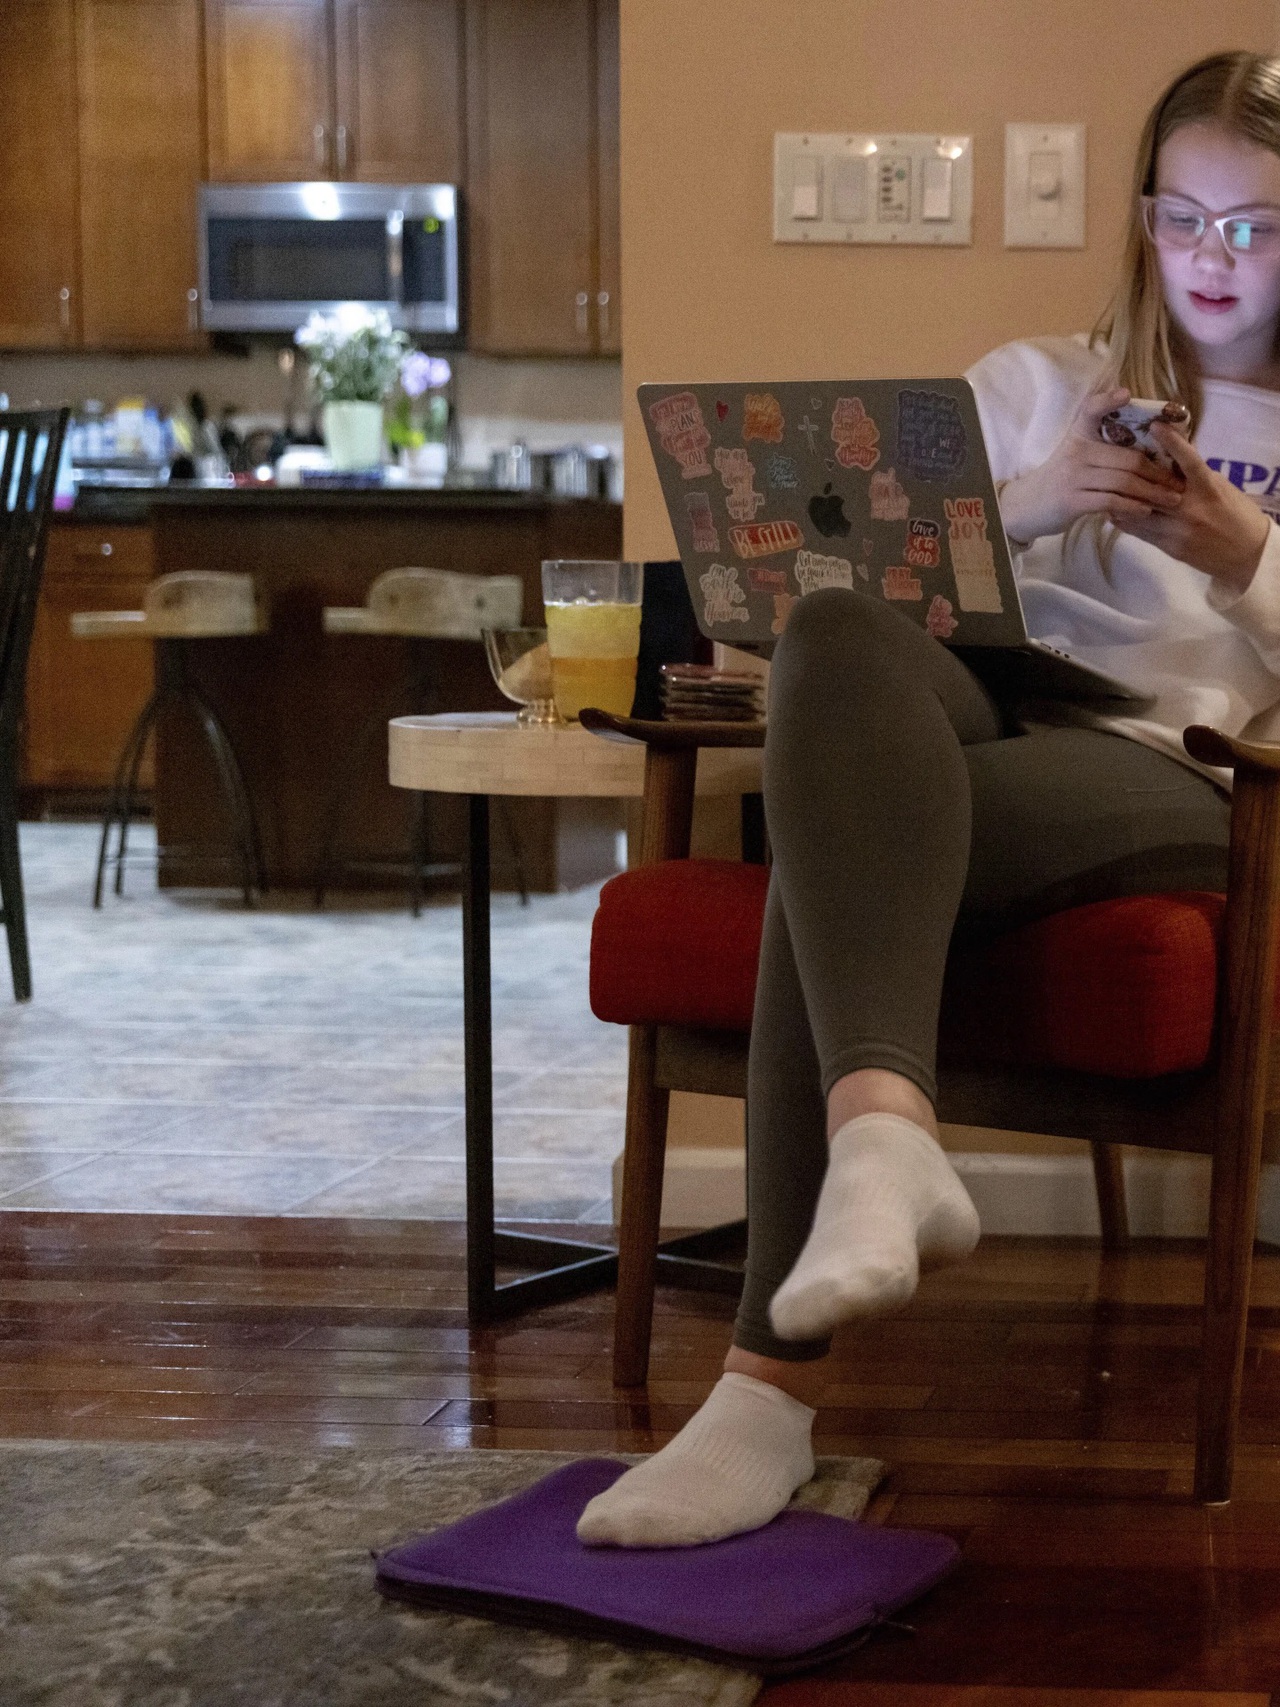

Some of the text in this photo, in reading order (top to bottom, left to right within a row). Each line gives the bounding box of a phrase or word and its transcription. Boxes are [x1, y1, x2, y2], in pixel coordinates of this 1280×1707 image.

[682, 450, 703, 467] YOU
[946, 500, 983, 518] LOVE
[912, 517, 935, 537] Give
[950, 520, 986, 541] JOY
[733, 522, 797, 558] BE STILL
[907, 551, 933, 565] GOD
